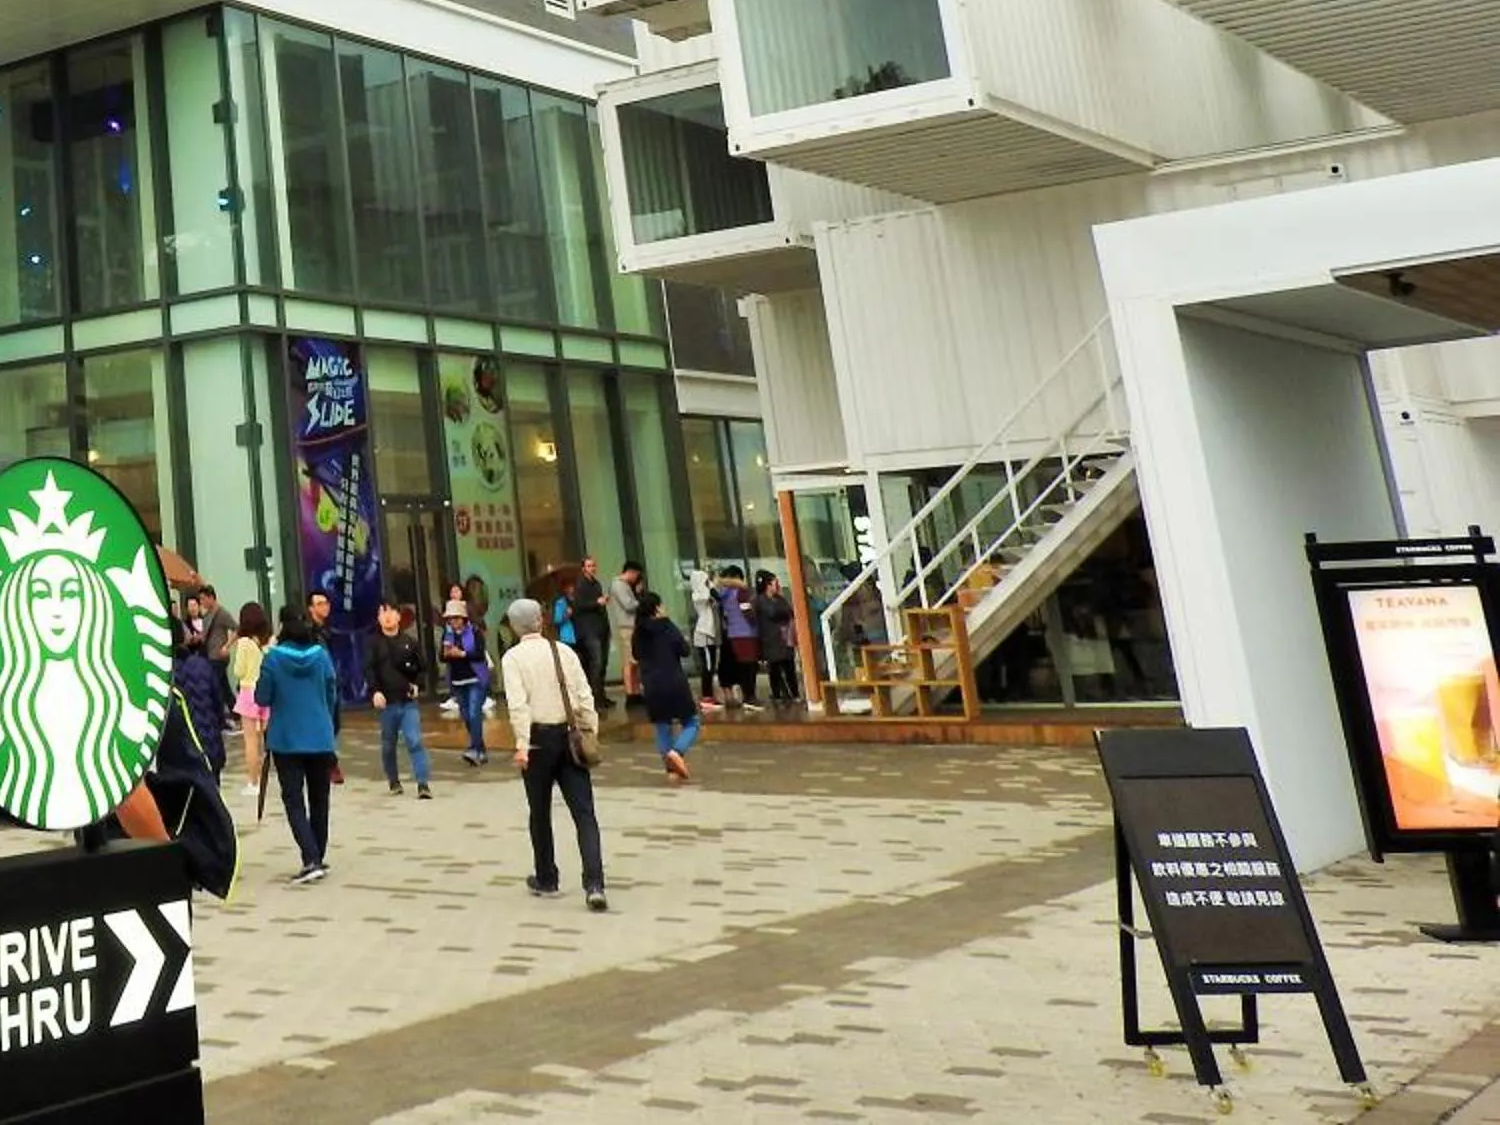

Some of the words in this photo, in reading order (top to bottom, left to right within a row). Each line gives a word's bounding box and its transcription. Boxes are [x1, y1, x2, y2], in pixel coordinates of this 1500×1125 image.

[305, 356, 353, 380] MAGIC
[306, 392, 356, 434] SLIDE
[1376, 596, 1448, 608] TEAVANA
[1202, 974, 1261, 984] STARBUCKS
[1263, 974, 1303, 984] COFFEE
